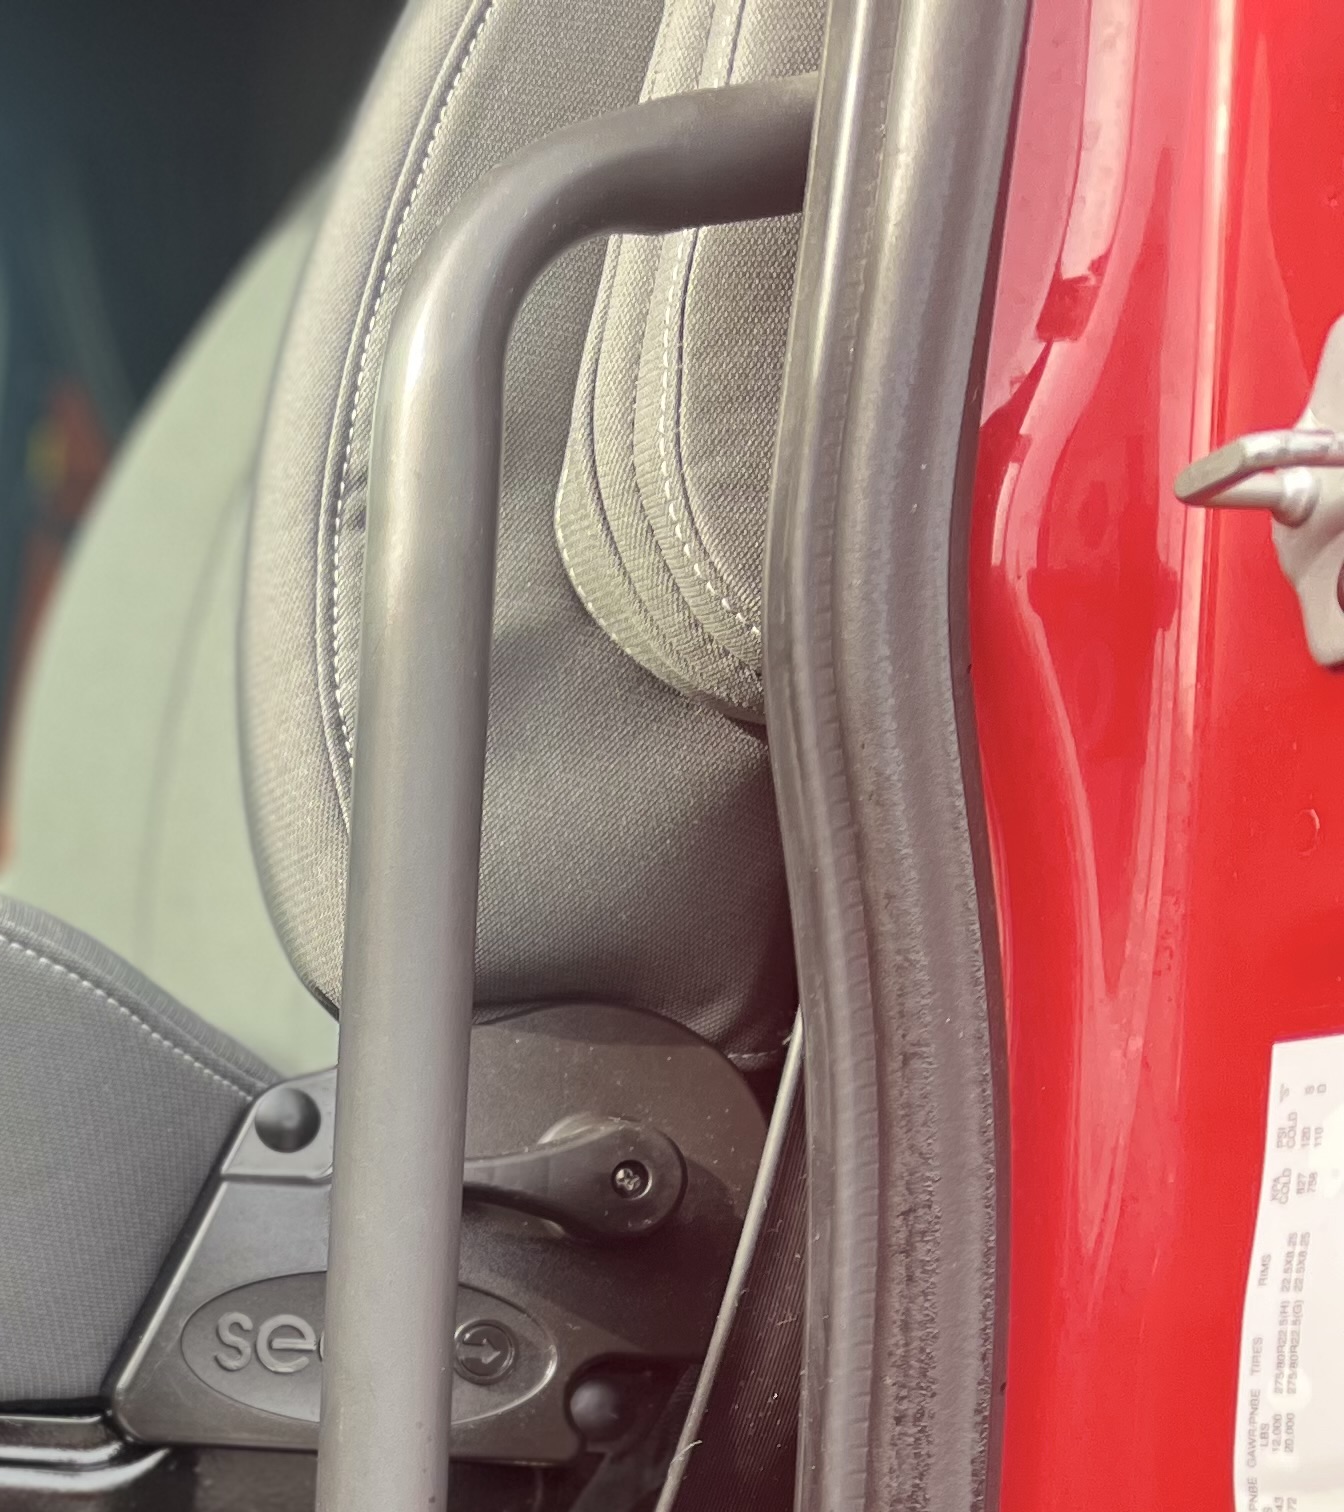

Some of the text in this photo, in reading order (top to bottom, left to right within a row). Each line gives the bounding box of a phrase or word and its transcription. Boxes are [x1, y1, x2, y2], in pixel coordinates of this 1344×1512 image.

[1250, 1337, 1263, 1376] TIRES
[1257, 1254, 1271, 1287] RIMS
[1269, 1176, 1281, 1202] KPA
[1276, 1127, 1287, 1149] PSI
[1300, 1126, 1311, 1148] 120
[1260, 1423, 1270, 1447] LBS
[1279, 1168, 1292, 1204] COLD
[1287, 1112, 1298, 1149] COLD
